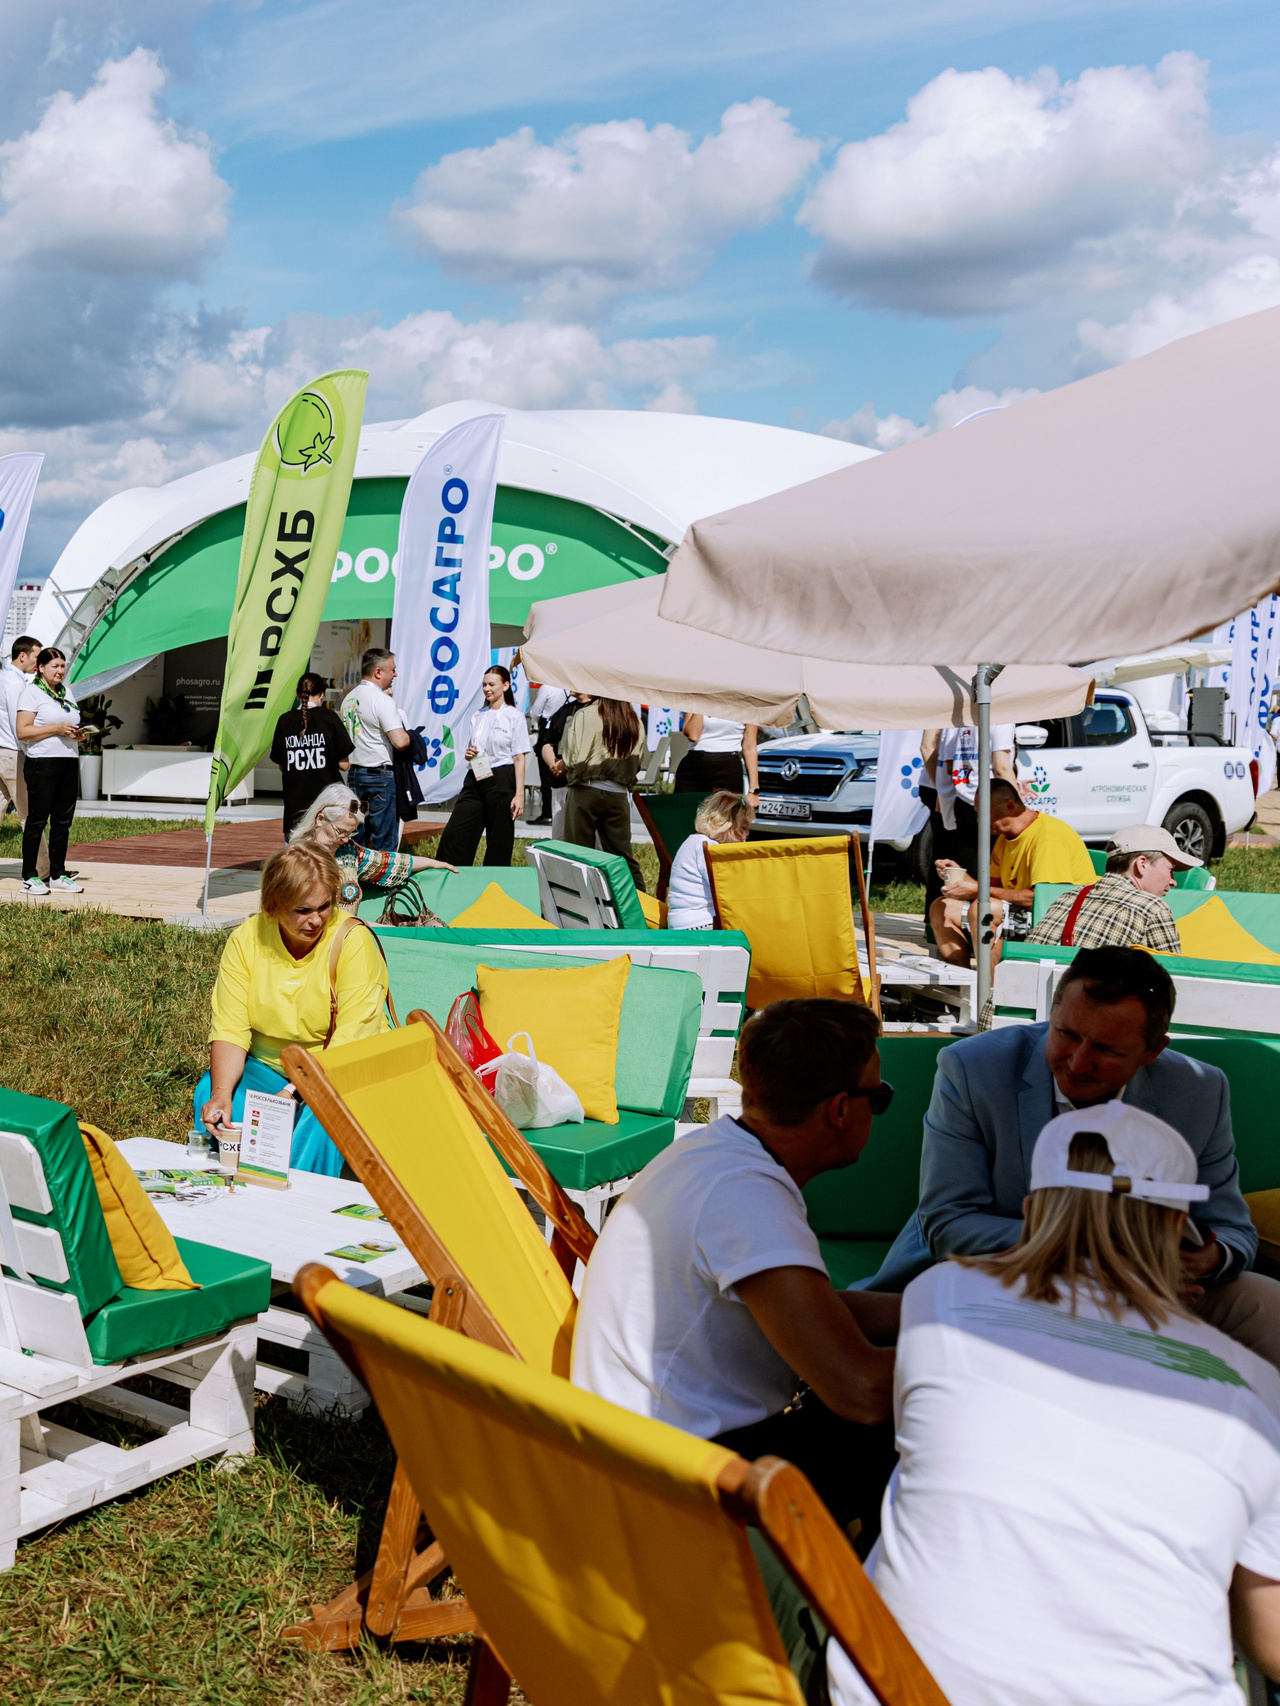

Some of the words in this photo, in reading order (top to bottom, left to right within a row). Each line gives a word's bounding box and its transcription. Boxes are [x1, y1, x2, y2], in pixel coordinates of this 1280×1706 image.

[259, 510, 315, 657] РСХБ
[427, 477, 470, 715] ФОСАГРО
[175, 677, 221, 687] phosagro.ru
[284, 732, 326, 749] КОМАНДА
[286, 747, 327, 772] РСХБ
